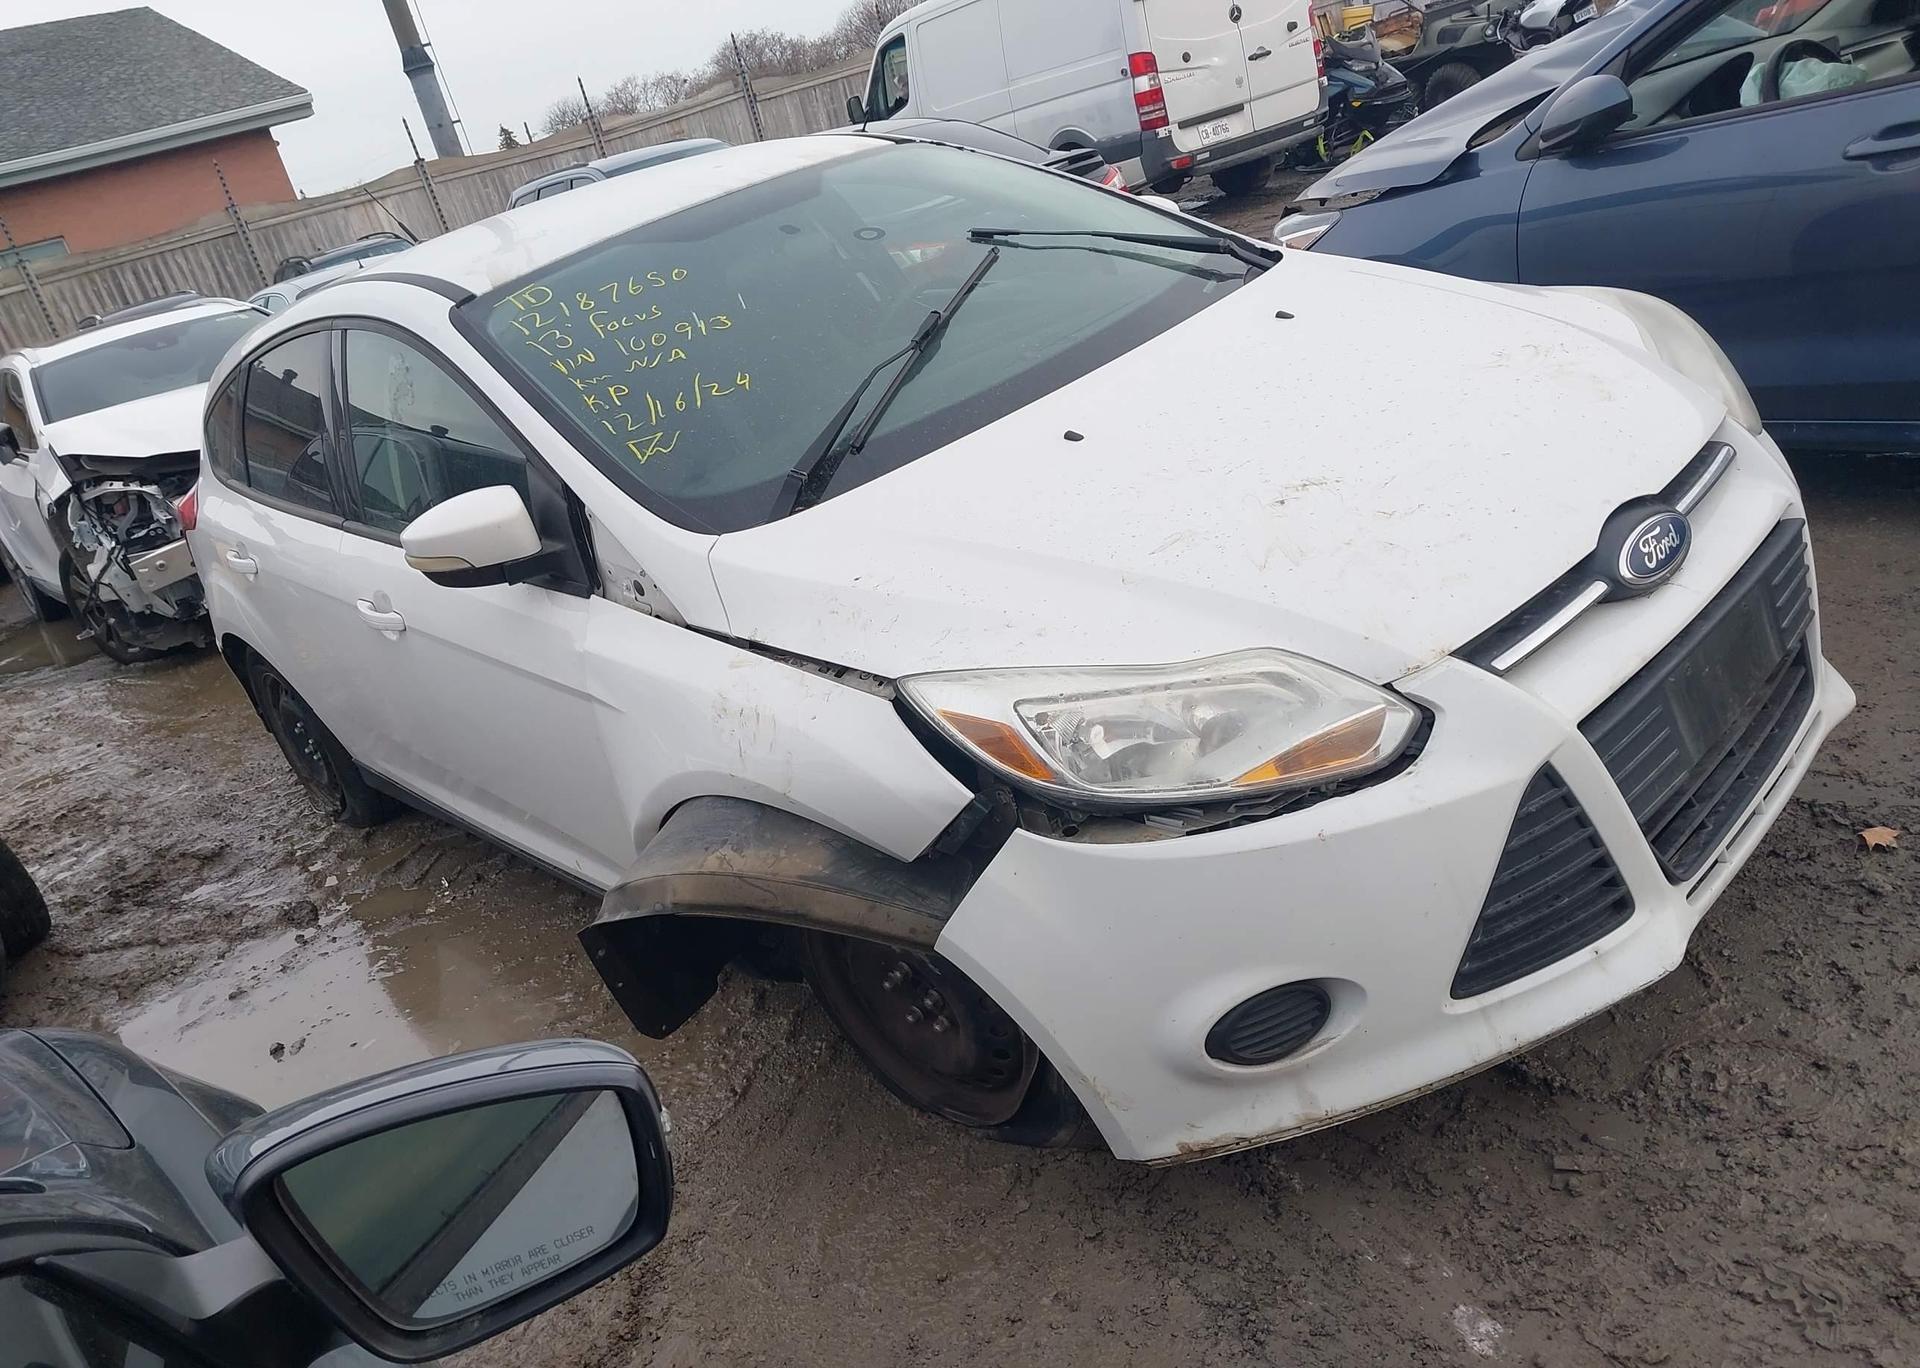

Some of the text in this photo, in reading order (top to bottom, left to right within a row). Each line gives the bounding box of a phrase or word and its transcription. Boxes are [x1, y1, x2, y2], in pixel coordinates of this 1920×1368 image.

[1639, 523, 1680, 569] Ford
[455, 1253, 562, 1303] THAN THEY APPEAR
[463, 1271, 477, 1286] IN
[481, 1252, 523, 1278] MIRROR
[527, 1243, 550, 1260] ARE
[553, 1225, 596, 1250] CLOSER
